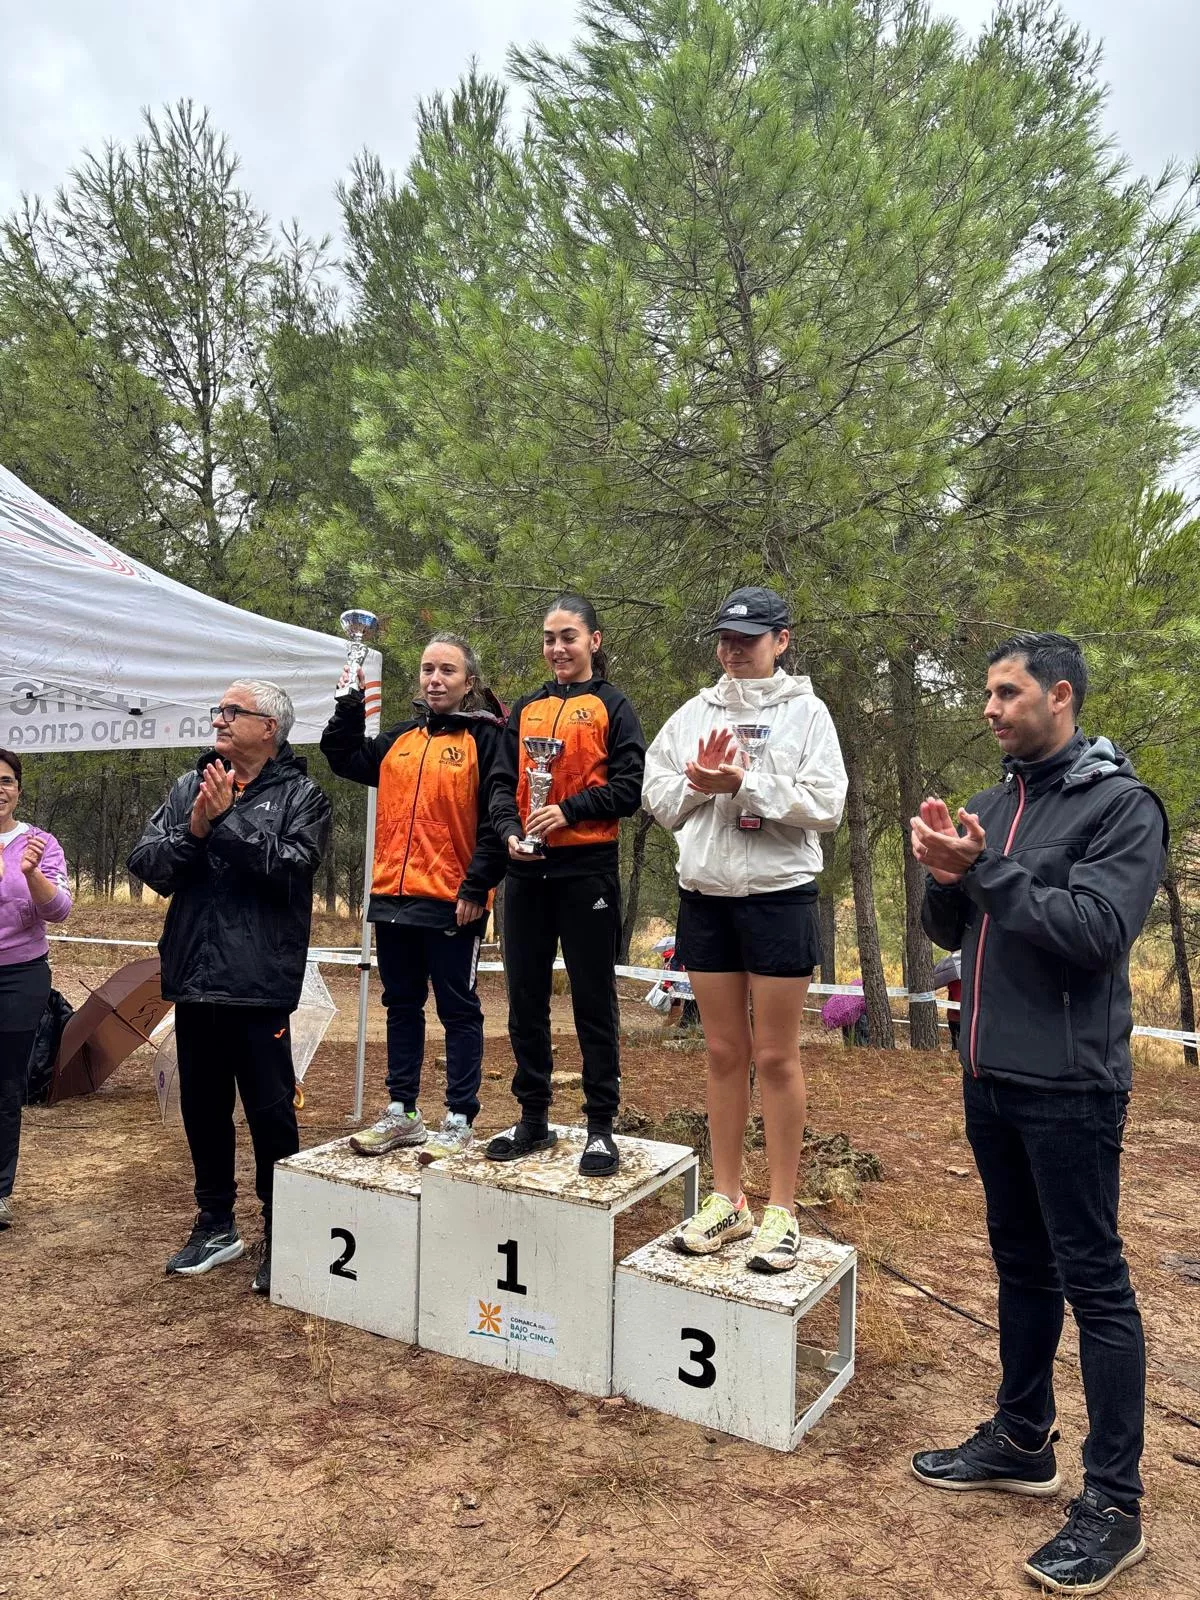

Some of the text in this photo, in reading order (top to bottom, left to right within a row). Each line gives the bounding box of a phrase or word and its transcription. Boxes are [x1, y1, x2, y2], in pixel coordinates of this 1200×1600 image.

[704, 1210, 740, 1240] TERREX
[330, 1227, 358, 1281] 2
[496, 1238, 528, 1296] 1
[510, 1316, 538, 1328] COMARCA
[510, 1323, 528, 1334] BAJO
[510, 1332, 554, 1344] BAIX CINCA
[677, 1327, 717, 1389] 3
